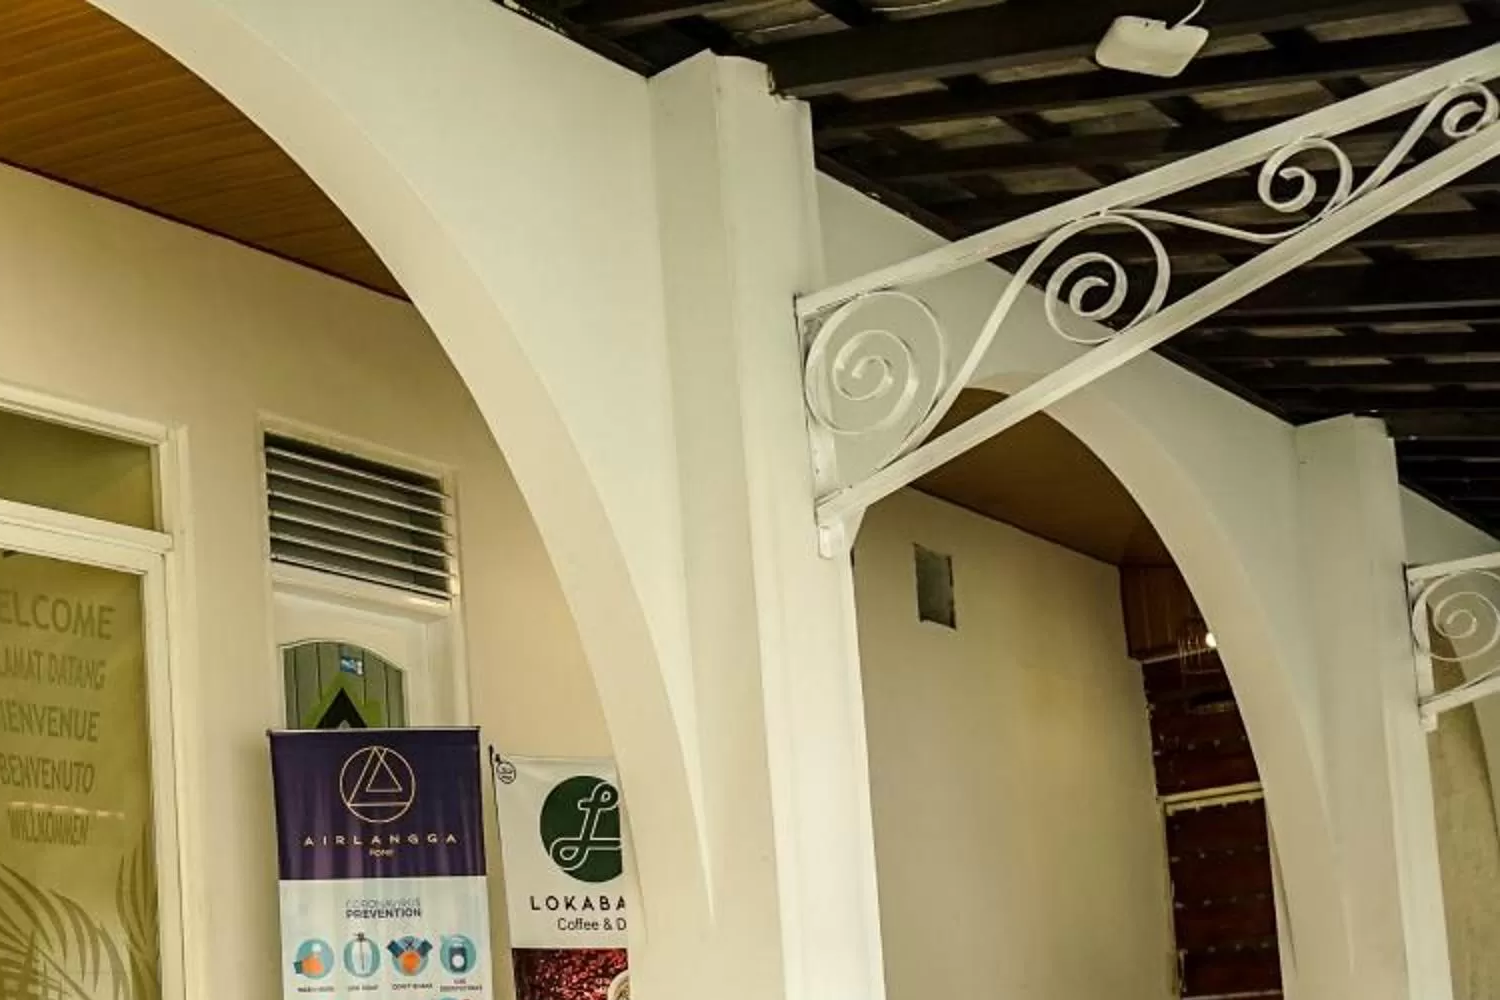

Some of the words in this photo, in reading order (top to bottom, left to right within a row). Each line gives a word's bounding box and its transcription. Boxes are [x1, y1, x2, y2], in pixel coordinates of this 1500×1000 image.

[50, 651, 106, 691] DATANG
[7, 808, 90, 846] WILLKOMMEN
[303, 833, 458, 846] AIRLANGGA
[345, 907, 422, 919] PREVENTION
[557, 917, 599, 931] Coffee
[603, 917, 612, 931] &
